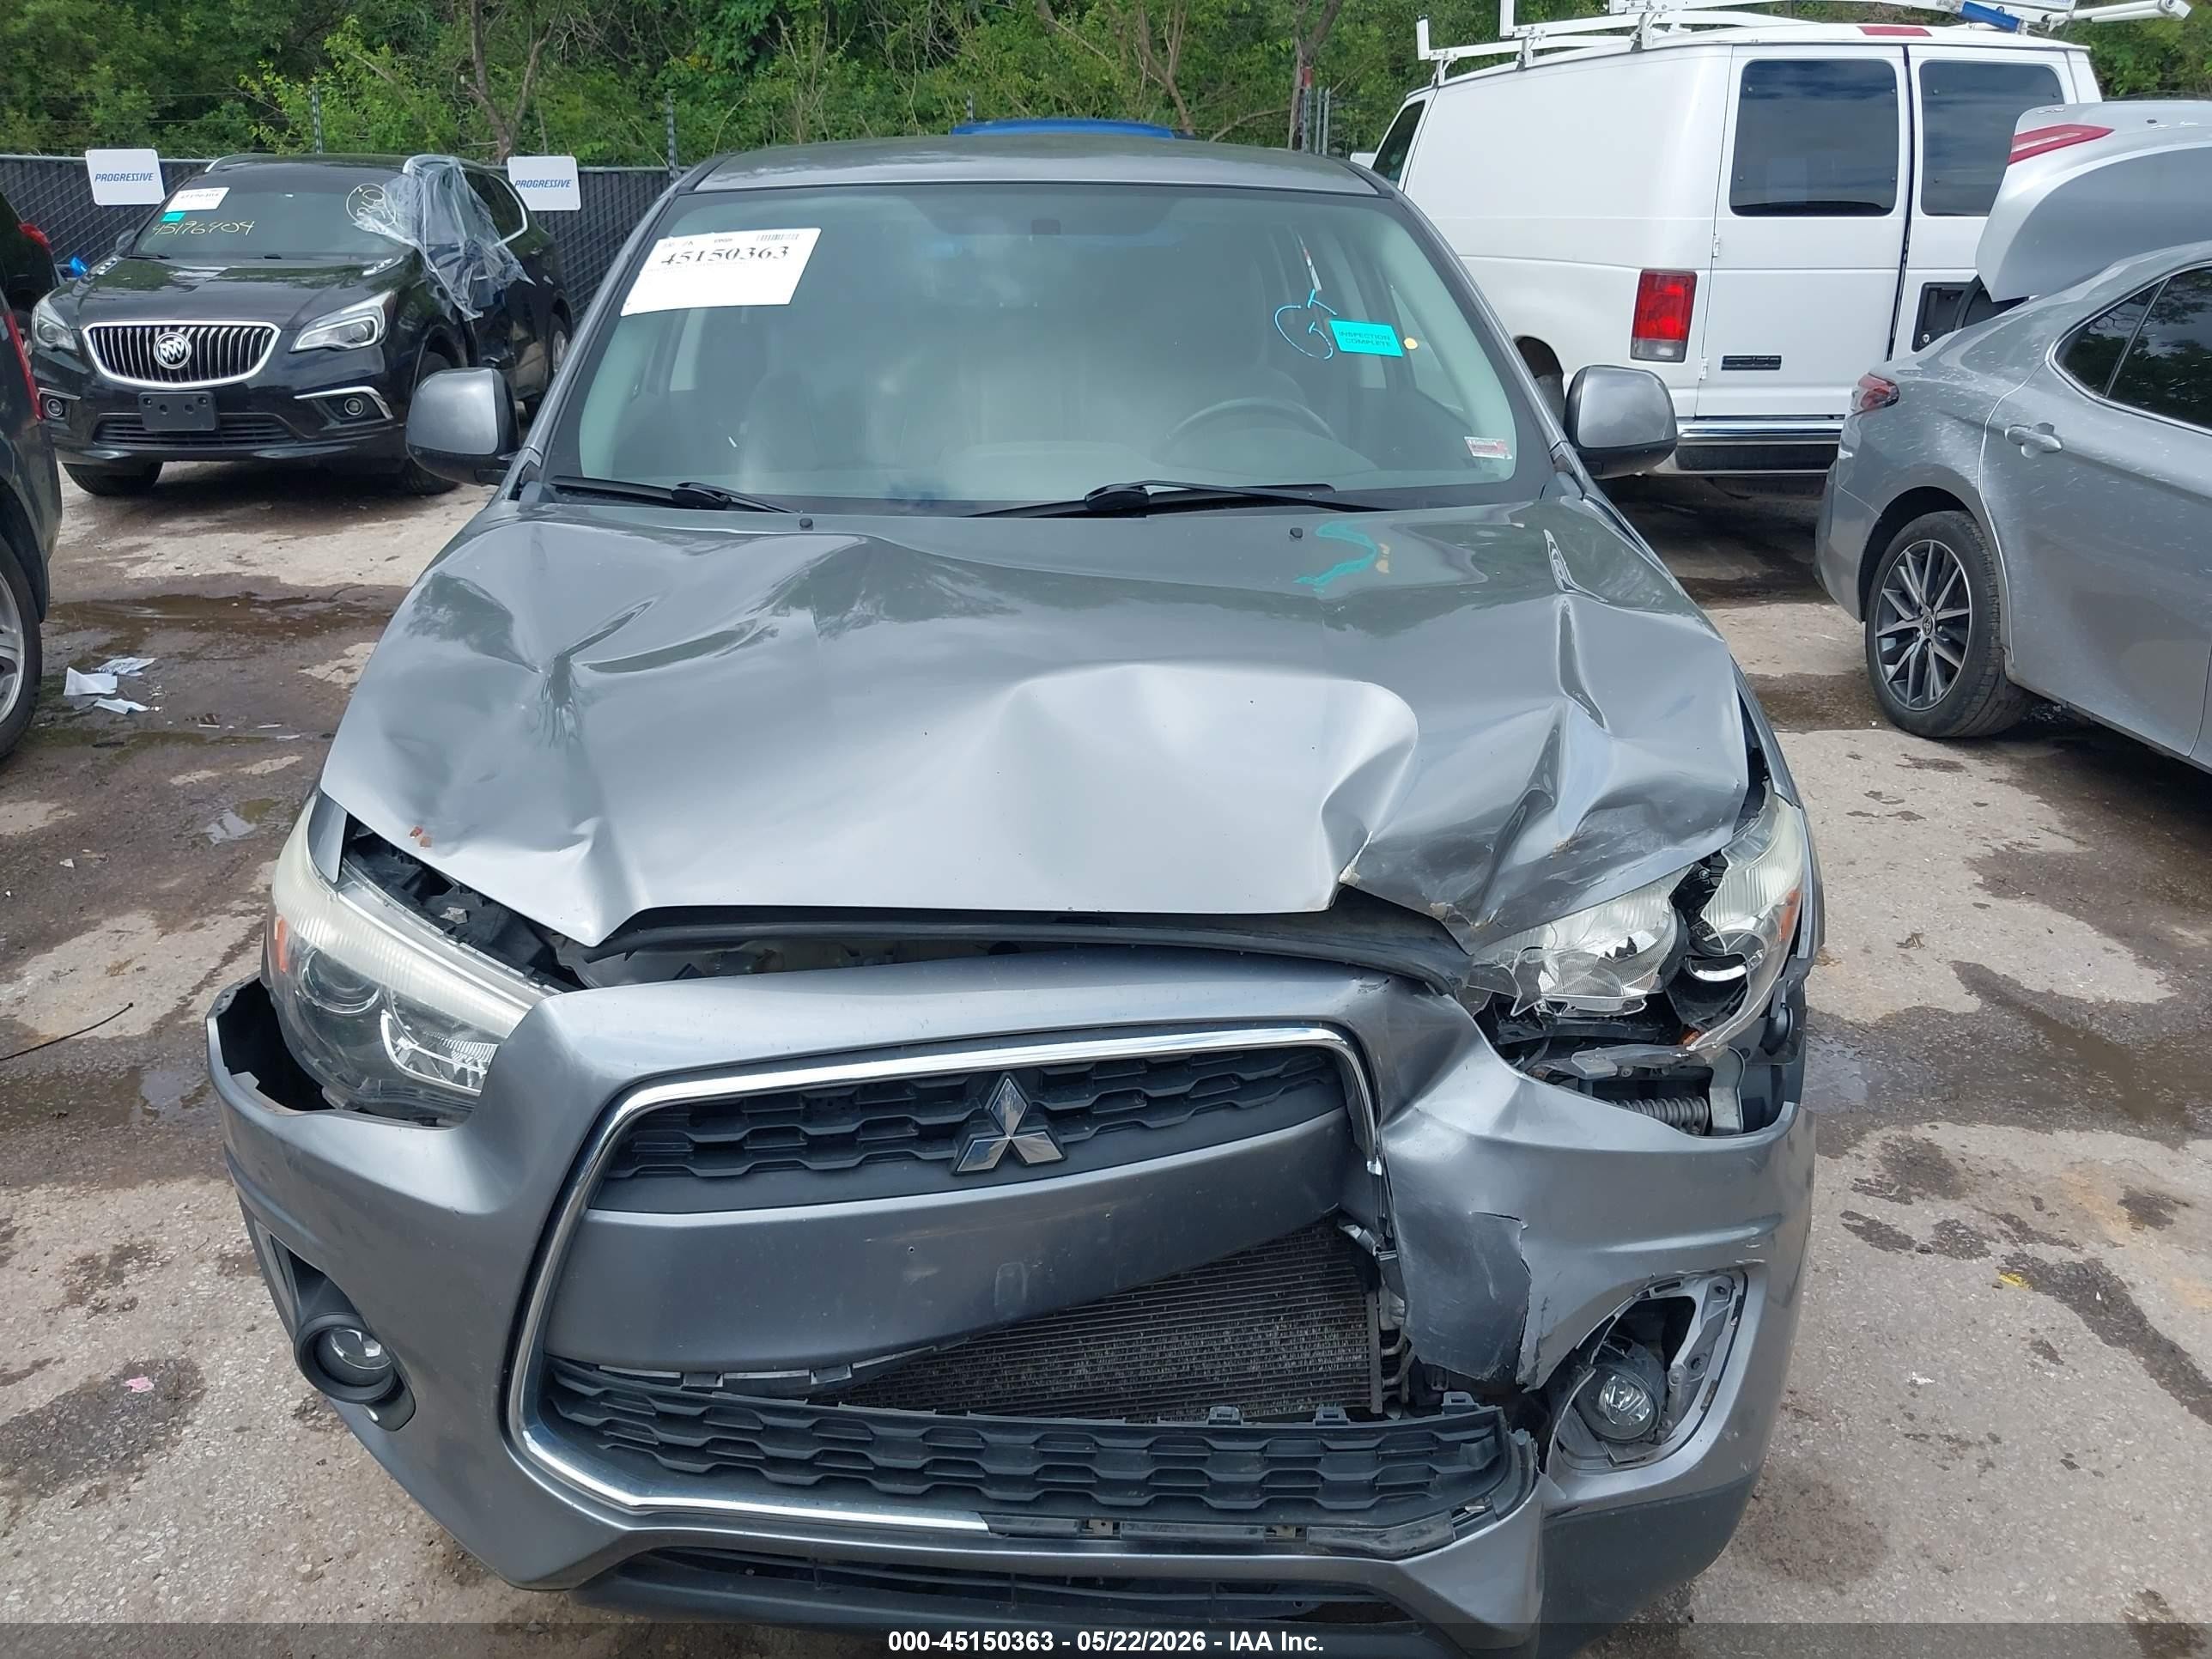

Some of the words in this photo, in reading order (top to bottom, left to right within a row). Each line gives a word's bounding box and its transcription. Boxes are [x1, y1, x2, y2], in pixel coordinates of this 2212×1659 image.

[95, 173, 154, 182] PROGRESSIVE
[515, 179, 572, 188] PROGRESSIVE
[660, 246, 789, 265] 45150363
